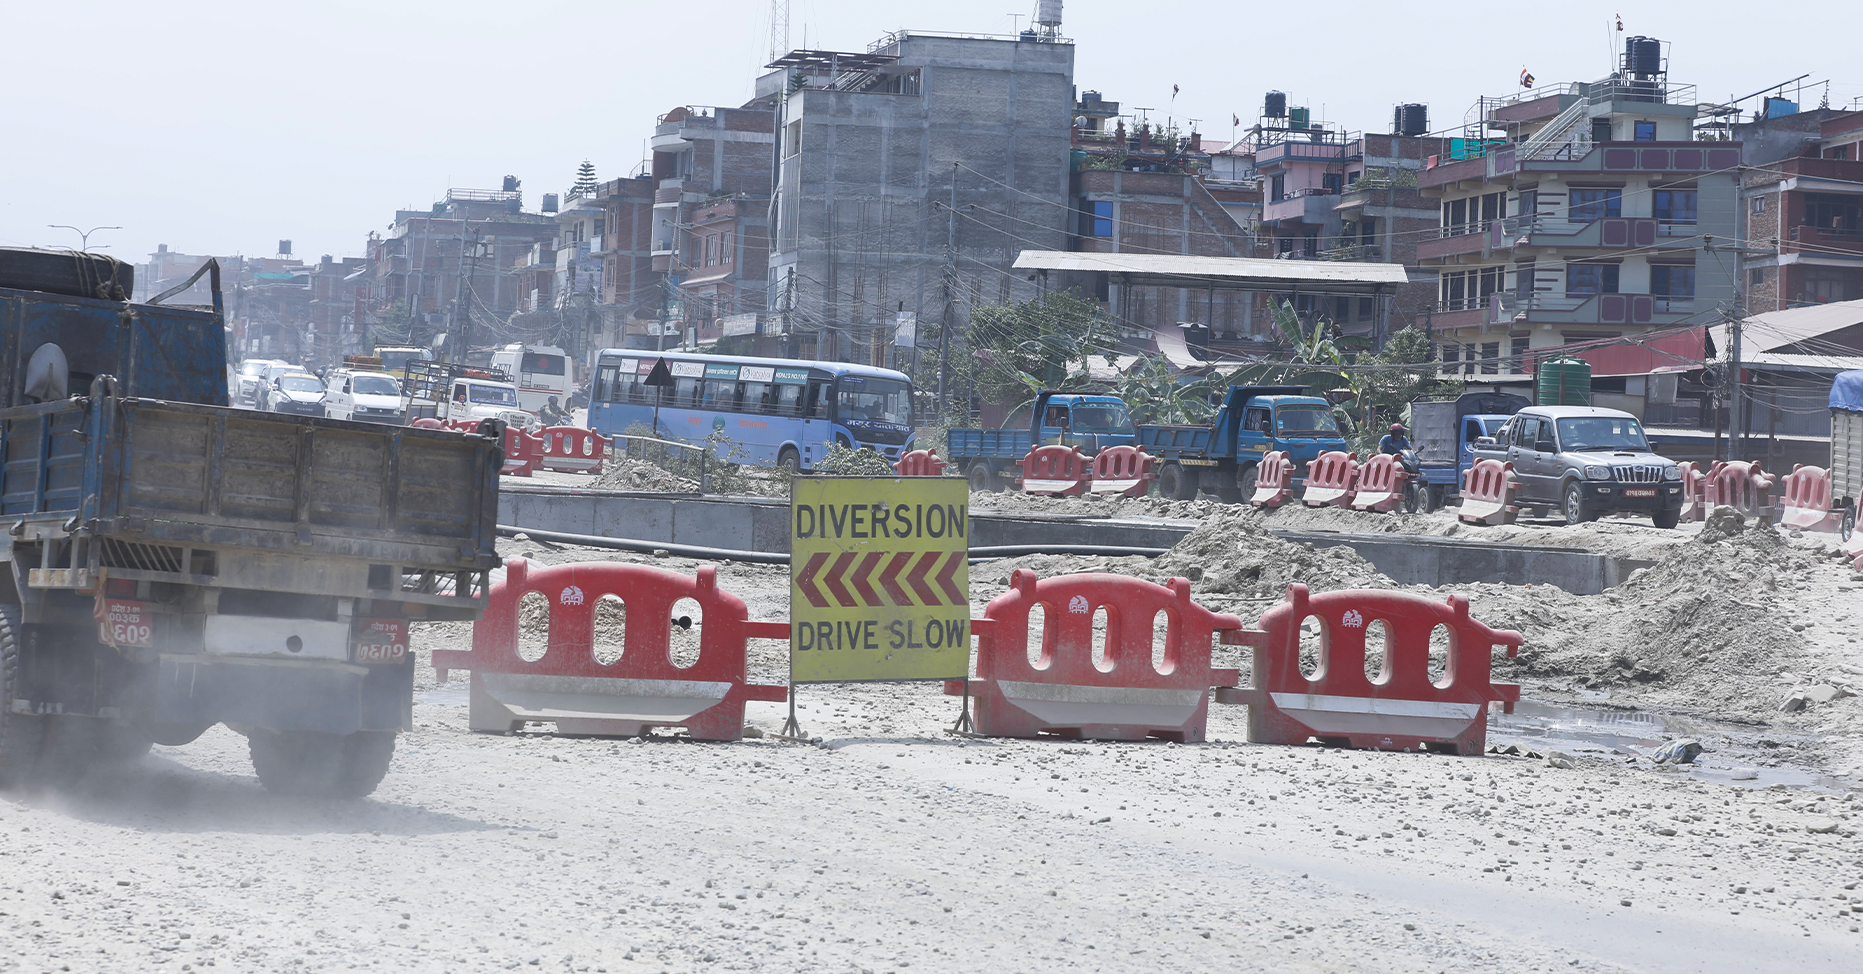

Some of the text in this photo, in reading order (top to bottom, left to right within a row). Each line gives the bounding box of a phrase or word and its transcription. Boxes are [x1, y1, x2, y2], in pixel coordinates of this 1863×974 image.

[737, 419, 768, 429] यातायात
[846, 419, 910, 432] मयूर यातायात
[796, 503, 965, 539] DIVERSION
[797, 618, 965, 651] DRIVE SLOW
